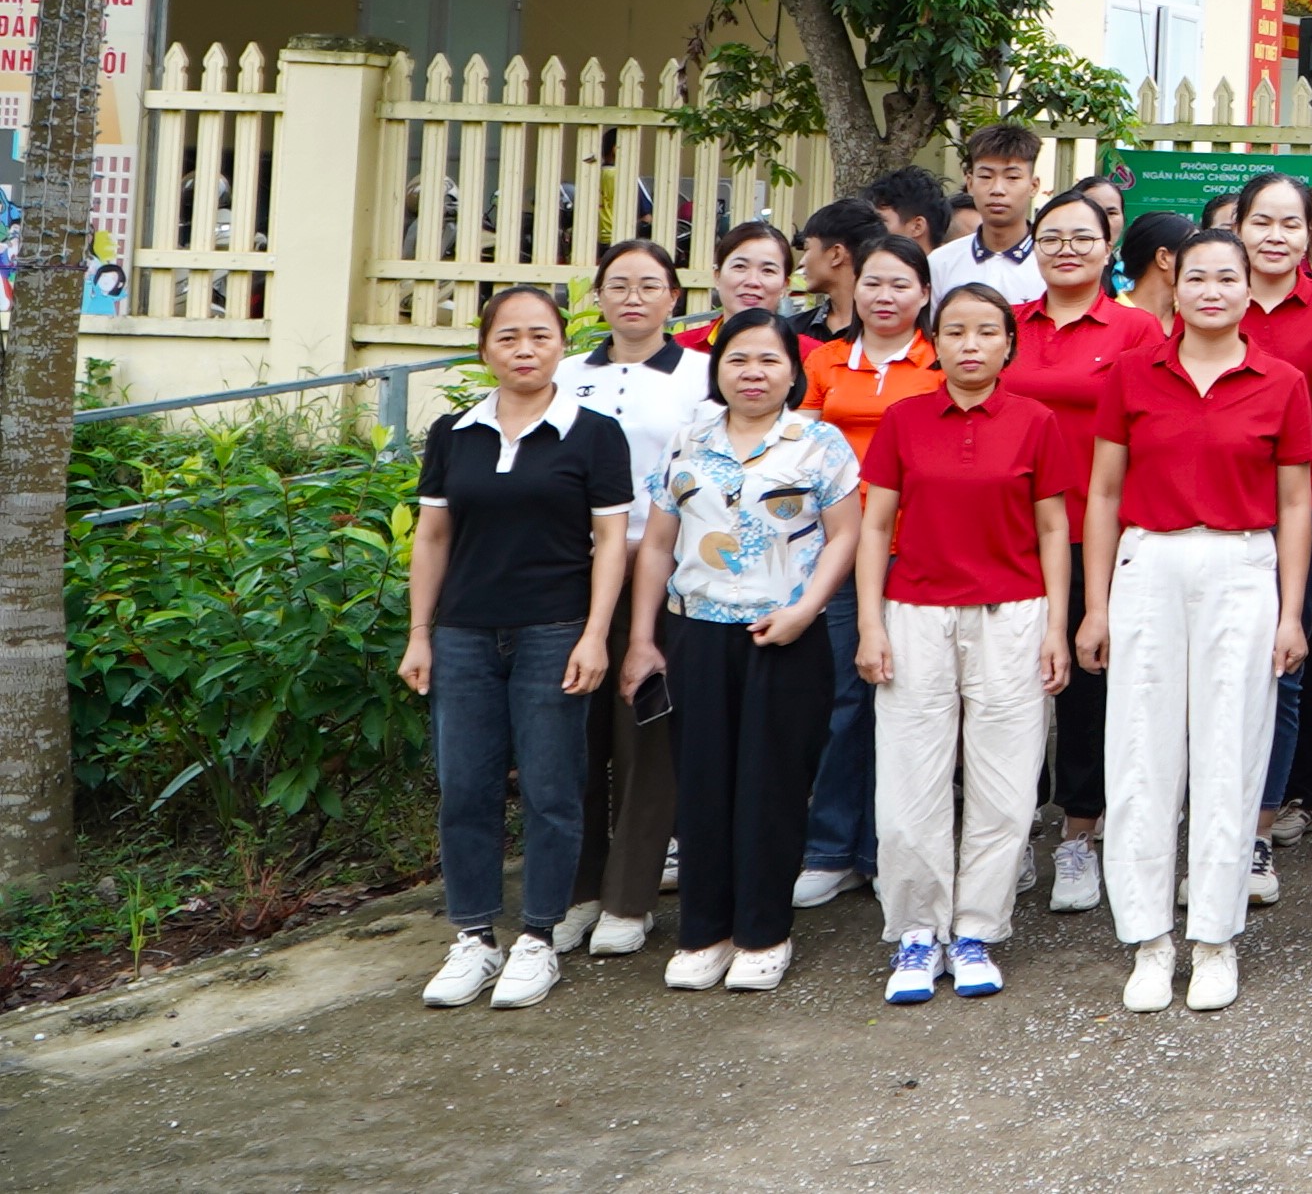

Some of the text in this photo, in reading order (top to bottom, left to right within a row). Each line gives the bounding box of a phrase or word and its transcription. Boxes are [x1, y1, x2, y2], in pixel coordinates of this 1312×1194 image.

[1180, 160, 1275, 174] PHÒNG GIAO DỊCH
[1142, 170, 1172, 180] NGÂN
[1175, 170, 1204, 181] HÀNG
[1207, 170, 1239, 181] CHÍNH
